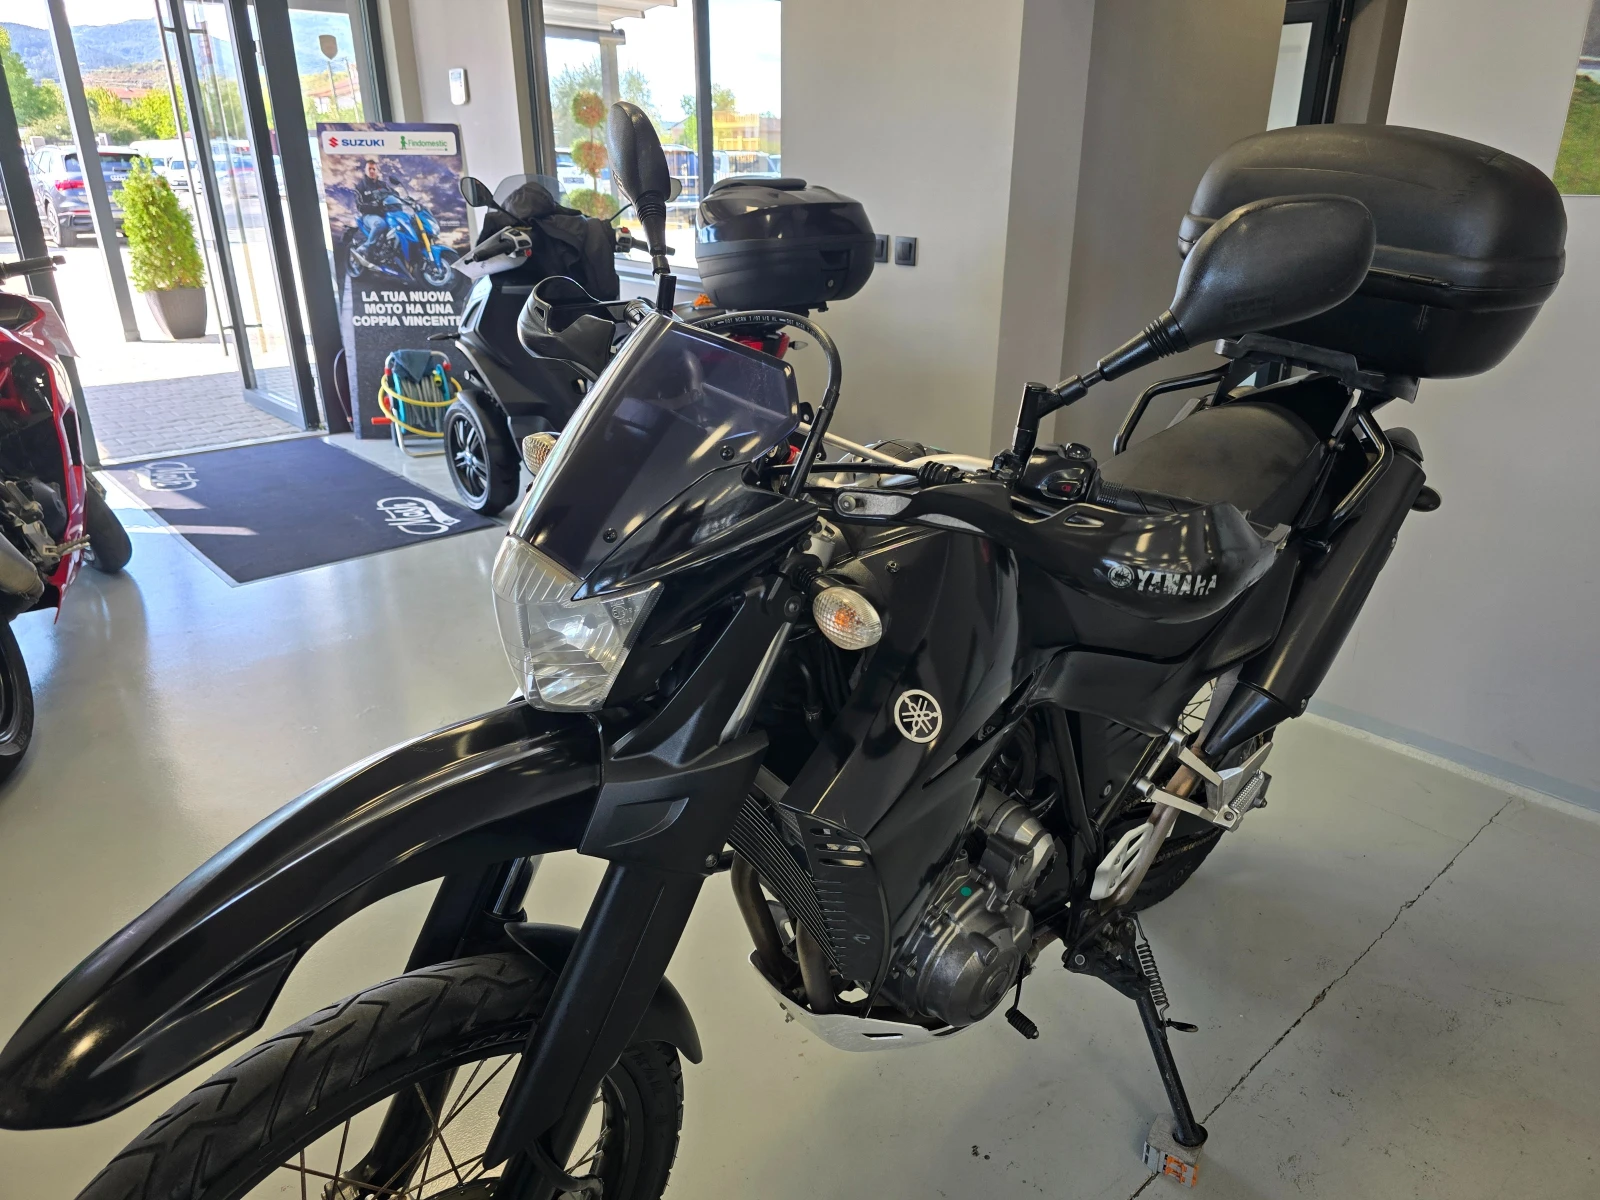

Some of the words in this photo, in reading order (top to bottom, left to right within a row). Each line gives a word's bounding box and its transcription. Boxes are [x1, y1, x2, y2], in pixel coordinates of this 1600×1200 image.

[341, 139, 385, 147] SUZUKI
[407, 139, 448, 148] Findomestic
[361, 291, 379, 302] LA
[381, 291, 408, 302] TUA
[409, 291, 454, 302] NUOVA
[364, 303, 404, 314] MOTO
[405, 303, 424, 314] HA
[426, 303, 454, 314] UNA
[352, 315, 401, 327] COPPIA
